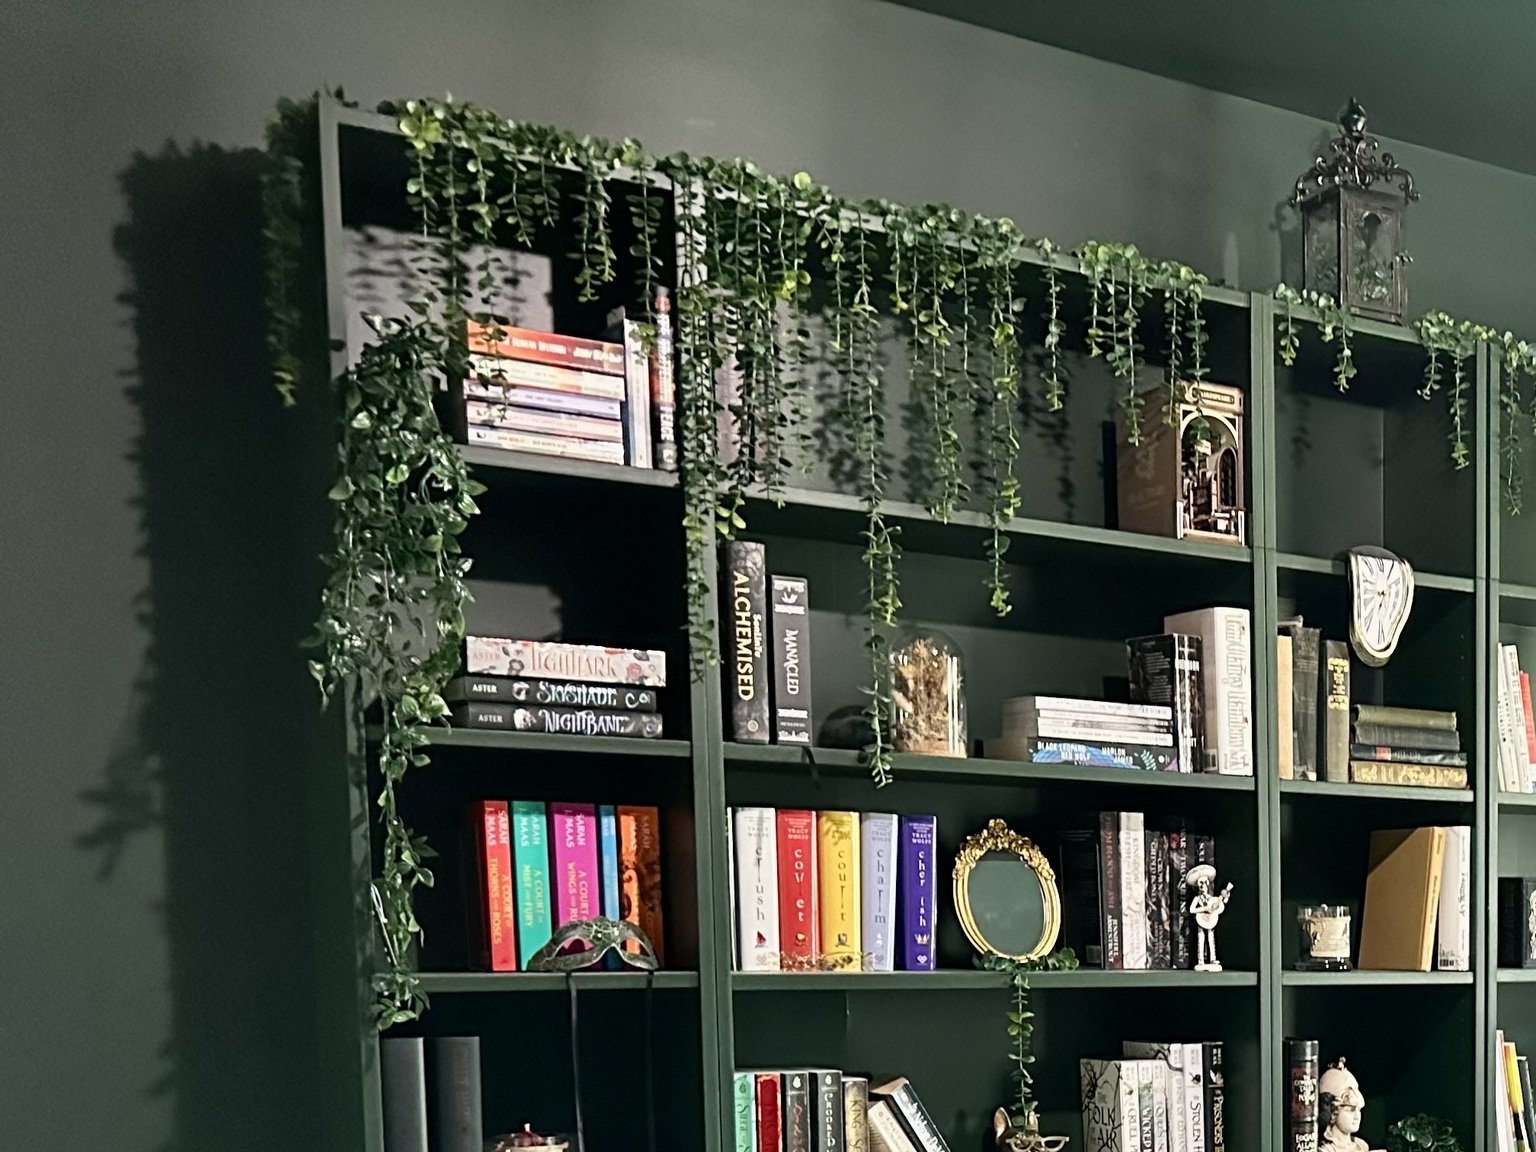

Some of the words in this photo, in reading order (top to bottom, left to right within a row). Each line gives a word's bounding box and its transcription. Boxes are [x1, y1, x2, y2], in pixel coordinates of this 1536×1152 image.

[734, 571, 754, 701] ALCHEMISED
[784, 629, 799, 694] MANACLED
[472, 684, 498, 693] ASTER
[536, 680, 618, 706] SKYSHADE
[478, 714, 503, 723] ASTER
[538, 708, 630, 735] NIGHTBANE
[1038, 741, 1058, 752] BLACK
[487, 816, 496, 846] MAAS
[498, 810, 510, 845] SARAH
[520, 816, 530, 847] MAAS
[565, 818, 574, 848] MAAS
[576, 812, 586, 846] SARAH
[489, 858, 500, 898] THORNS
[522, 864, 532, 887] MIST
[566, 862, 576, 895] WINGS
[756, 846, 765, 921] crush
[502, 884, 512, 920] COURT
[524, 900, 532, 927] FURY
[534, 879, 544, 917] COURT
[578, 880, 589, 916] COURT
[493, 910, 502, 944] ROSES
[737, 1104, 750, 1134] SIEGE
[850, 1099, 862, 1129] KING
[911, 1112, 930, 1138] Nelson
[1128, 1107, 1138, 1140] CRUEL
[1142, 1107, 1152, 1147] WICKED
[1156, 1106, 1165, 1138] QUEEN
[1190, 1101, 1201, 1142] STOLEN
